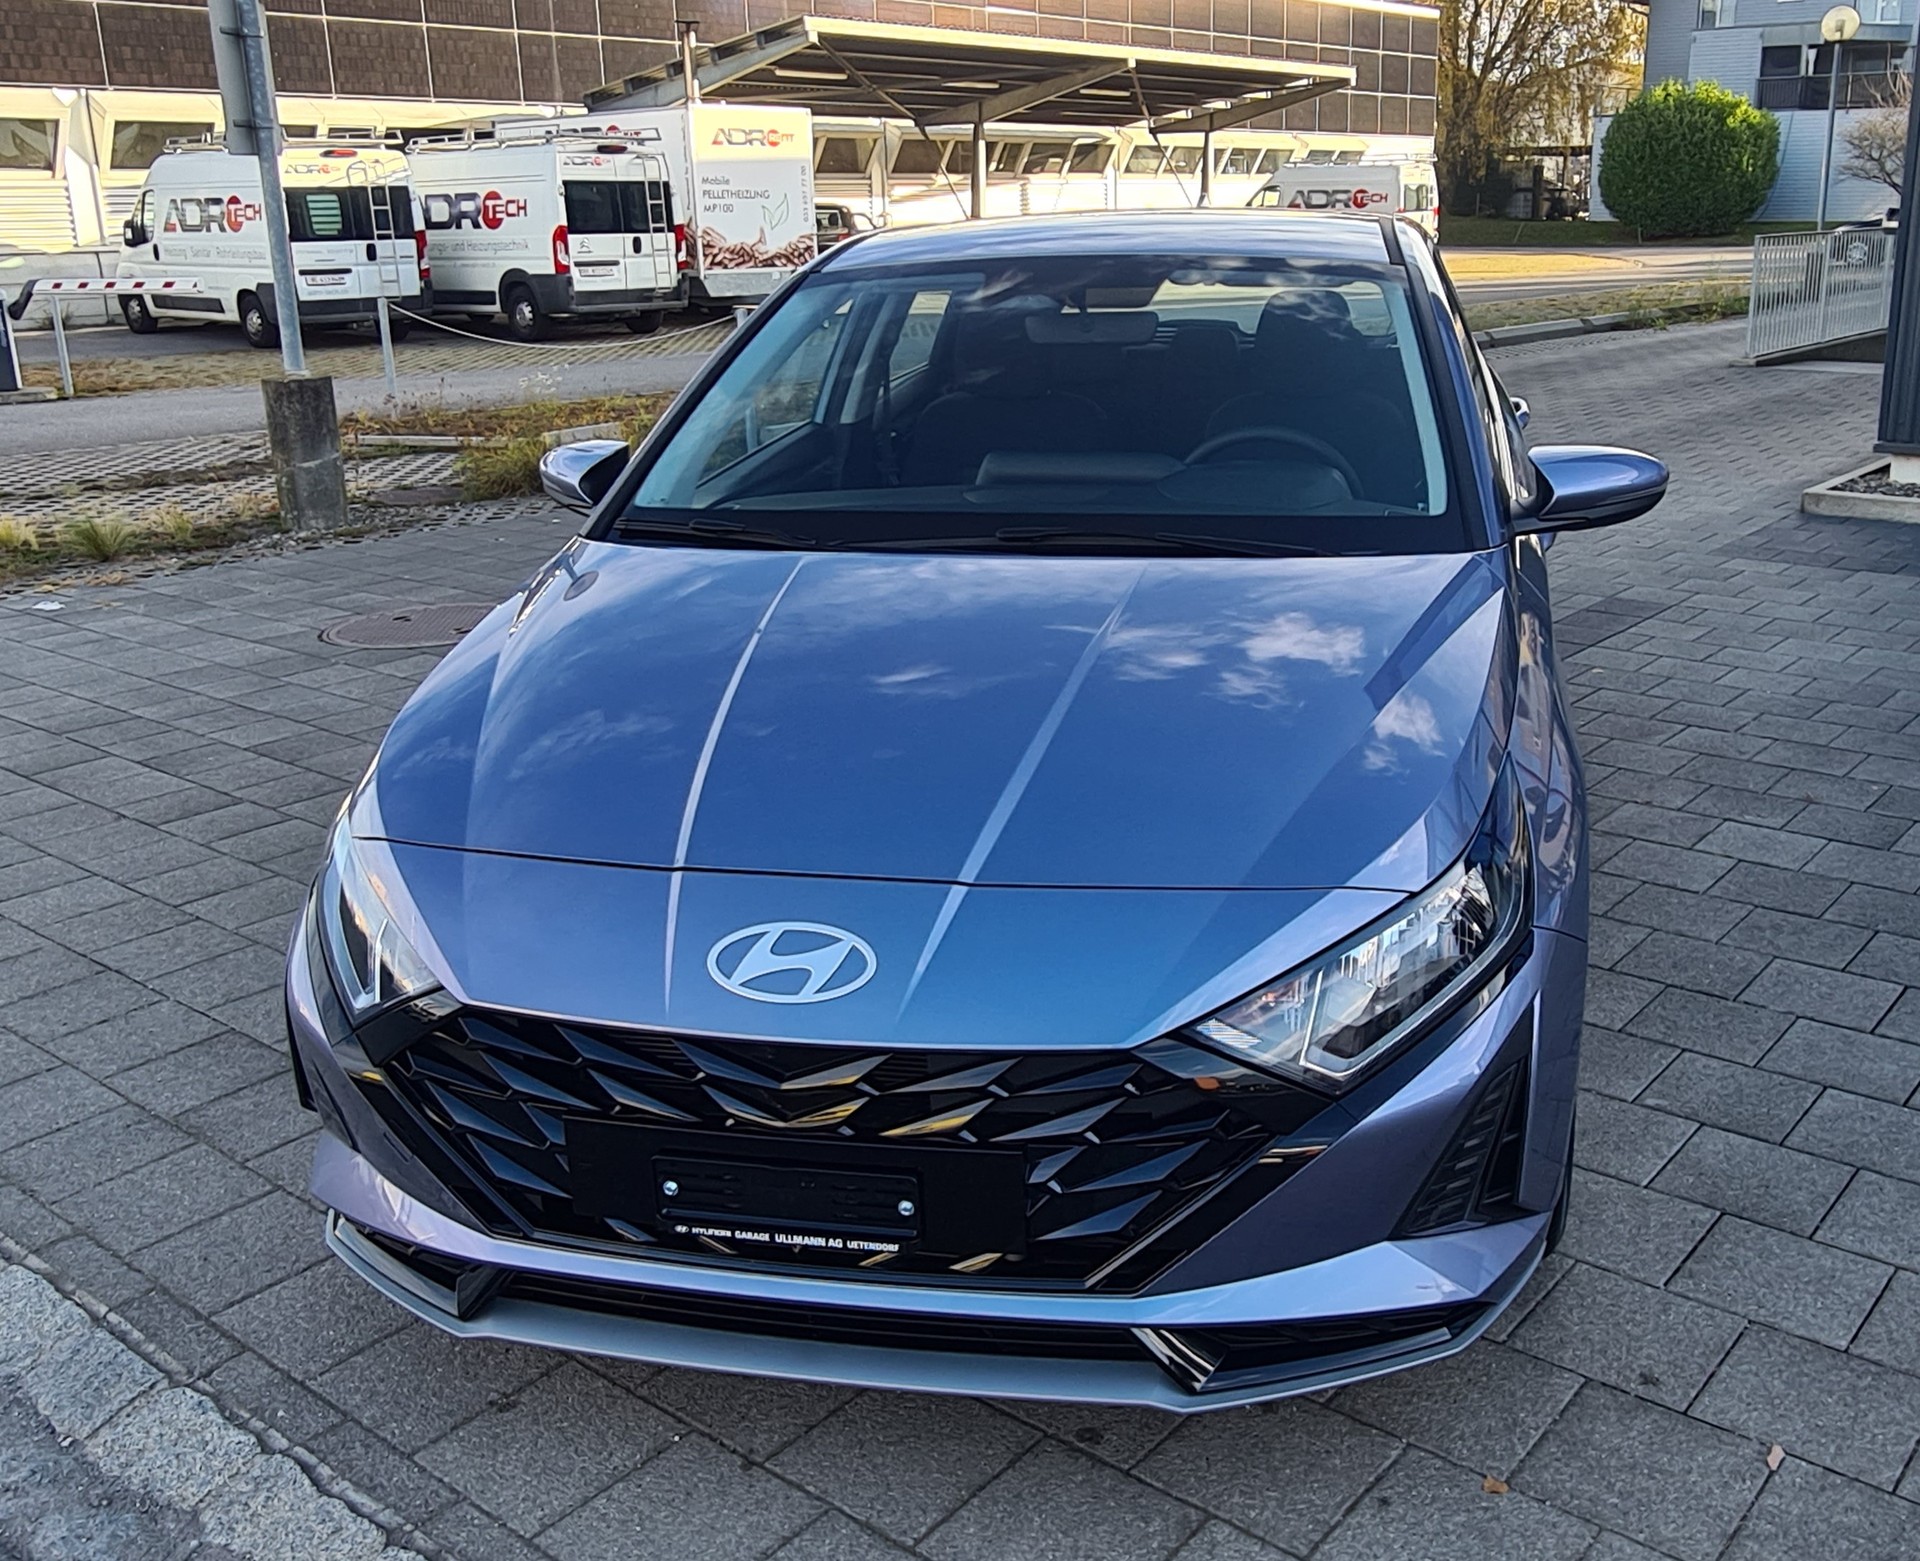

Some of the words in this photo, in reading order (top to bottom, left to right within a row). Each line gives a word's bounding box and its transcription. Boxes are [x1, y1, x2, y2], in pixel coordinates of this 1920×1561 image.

[701, 175, 731, 186] Mobile
[702, 189, 771, 200] PELLETHEIZUNG
[735, 1230, 770, 1242] GARAGE
[775, 1233, 826, 1247] ULLMANN
[828, 1238, 844, 1249] AG
